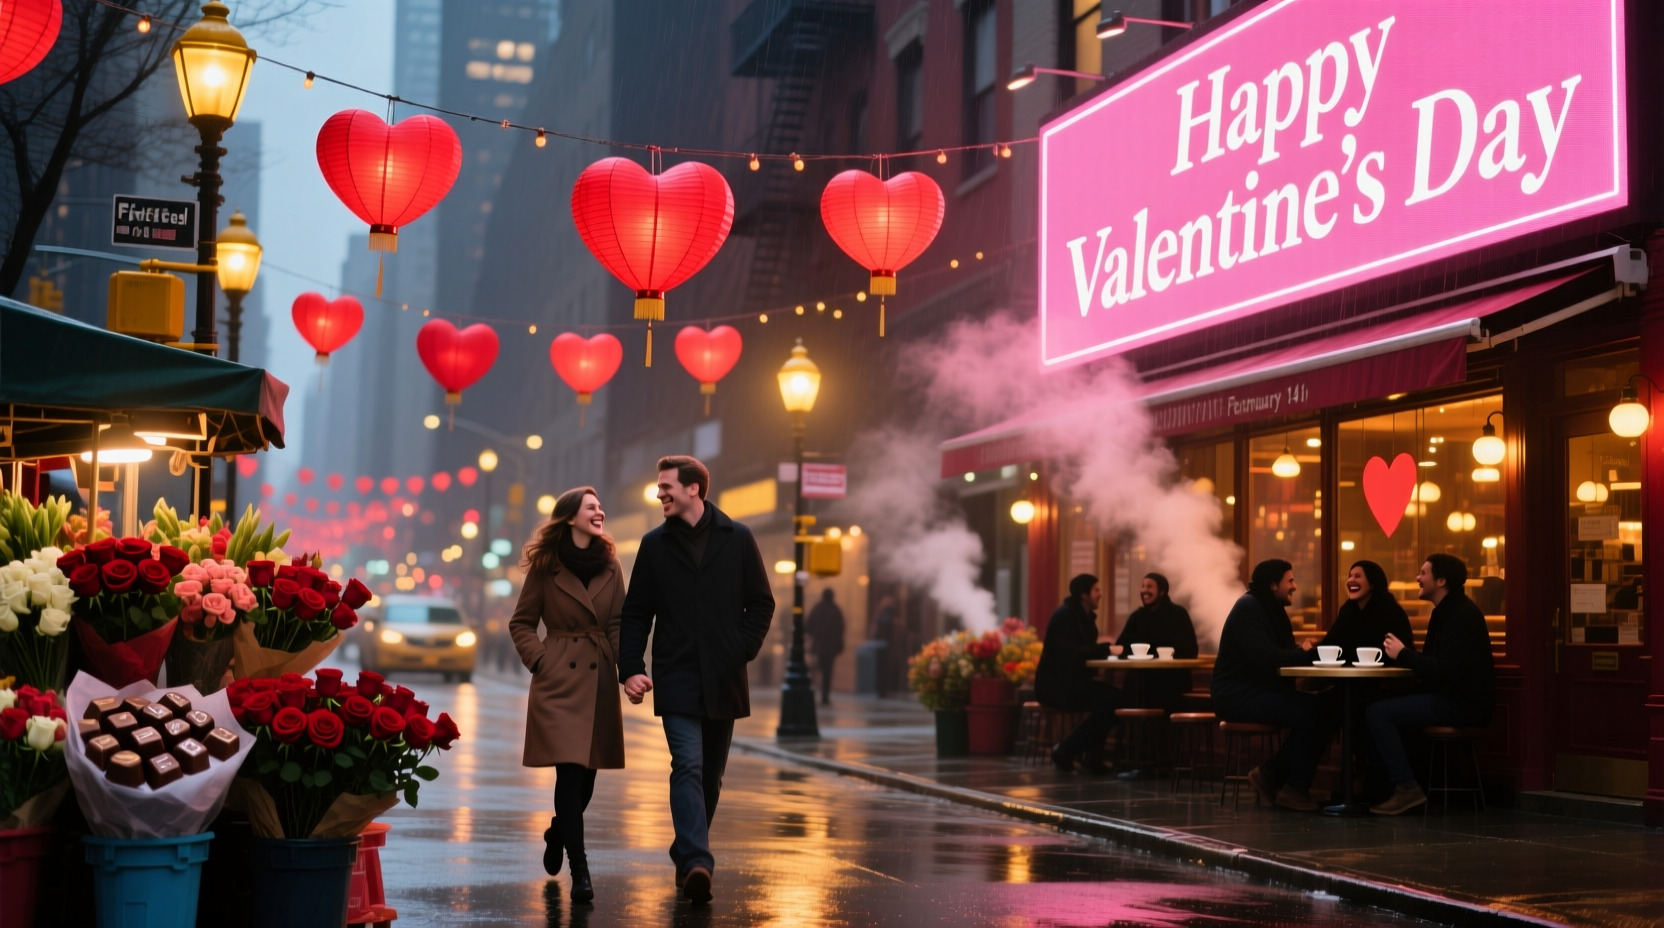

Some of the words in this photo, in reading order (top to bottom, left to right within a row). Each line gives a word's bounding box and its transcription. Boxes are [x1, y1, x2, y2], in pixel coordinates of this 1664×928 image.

[1066, 134, 1386, 318] Valentine's
[1404, 75, 1582, 206] Day
[1170, 16, 1396, 176] Happy
